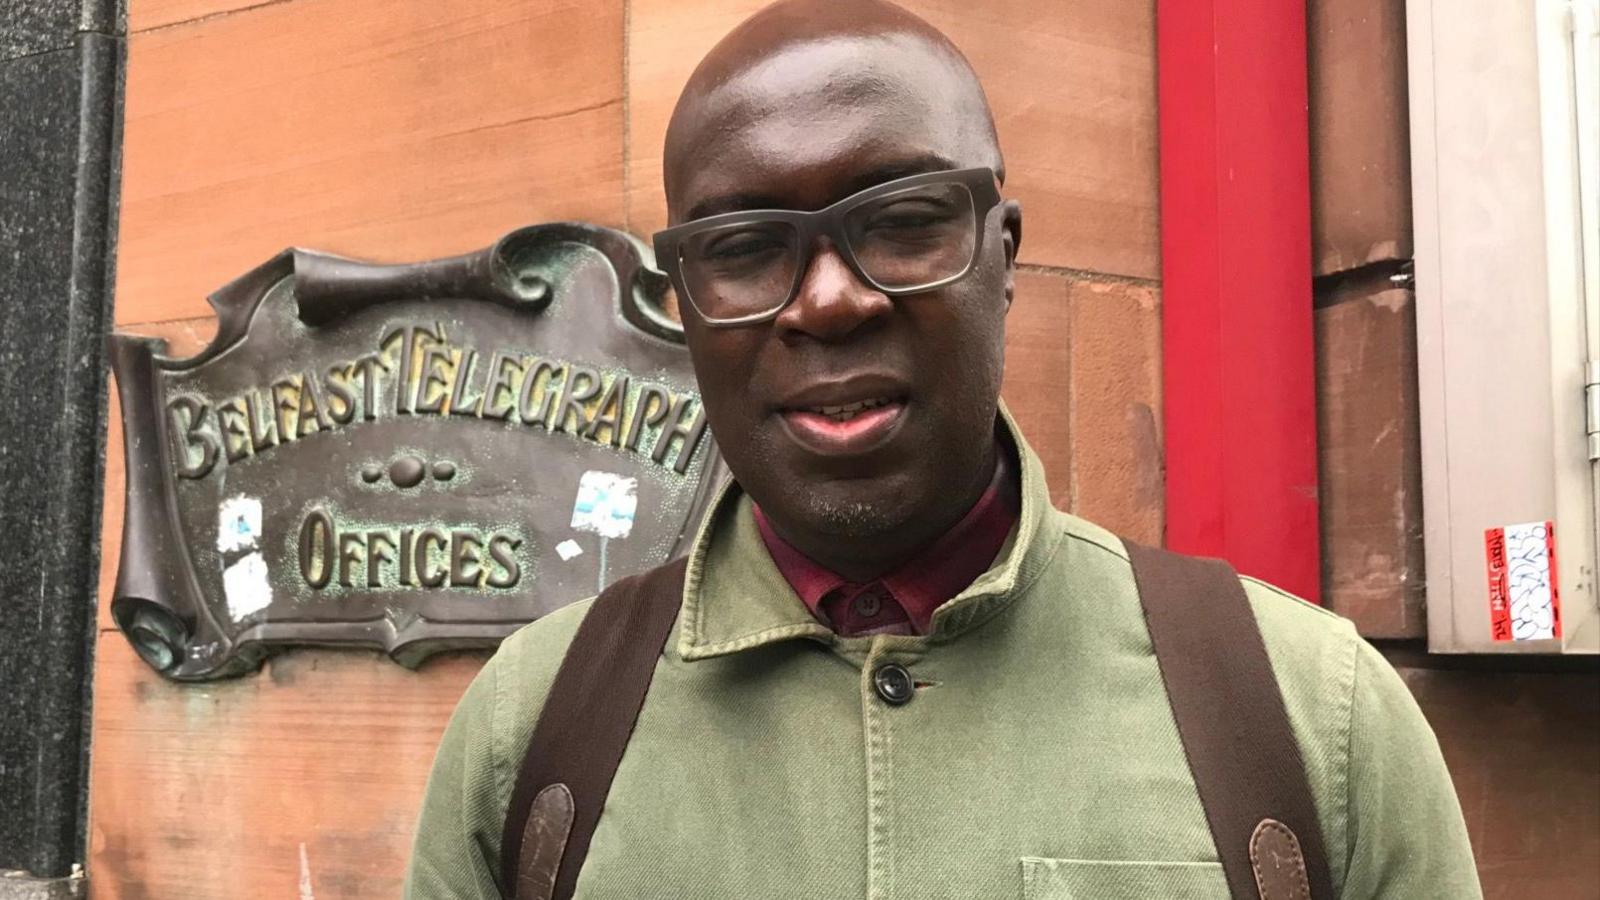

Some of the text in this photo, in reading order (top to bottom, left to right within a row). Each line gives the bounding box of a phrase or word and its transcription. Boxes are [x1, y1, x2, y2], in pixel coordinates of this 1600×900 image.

[167, 321, 708, 479] BELFAST TELEGRAPH
[299, 511, 523, 589] OFFICES
